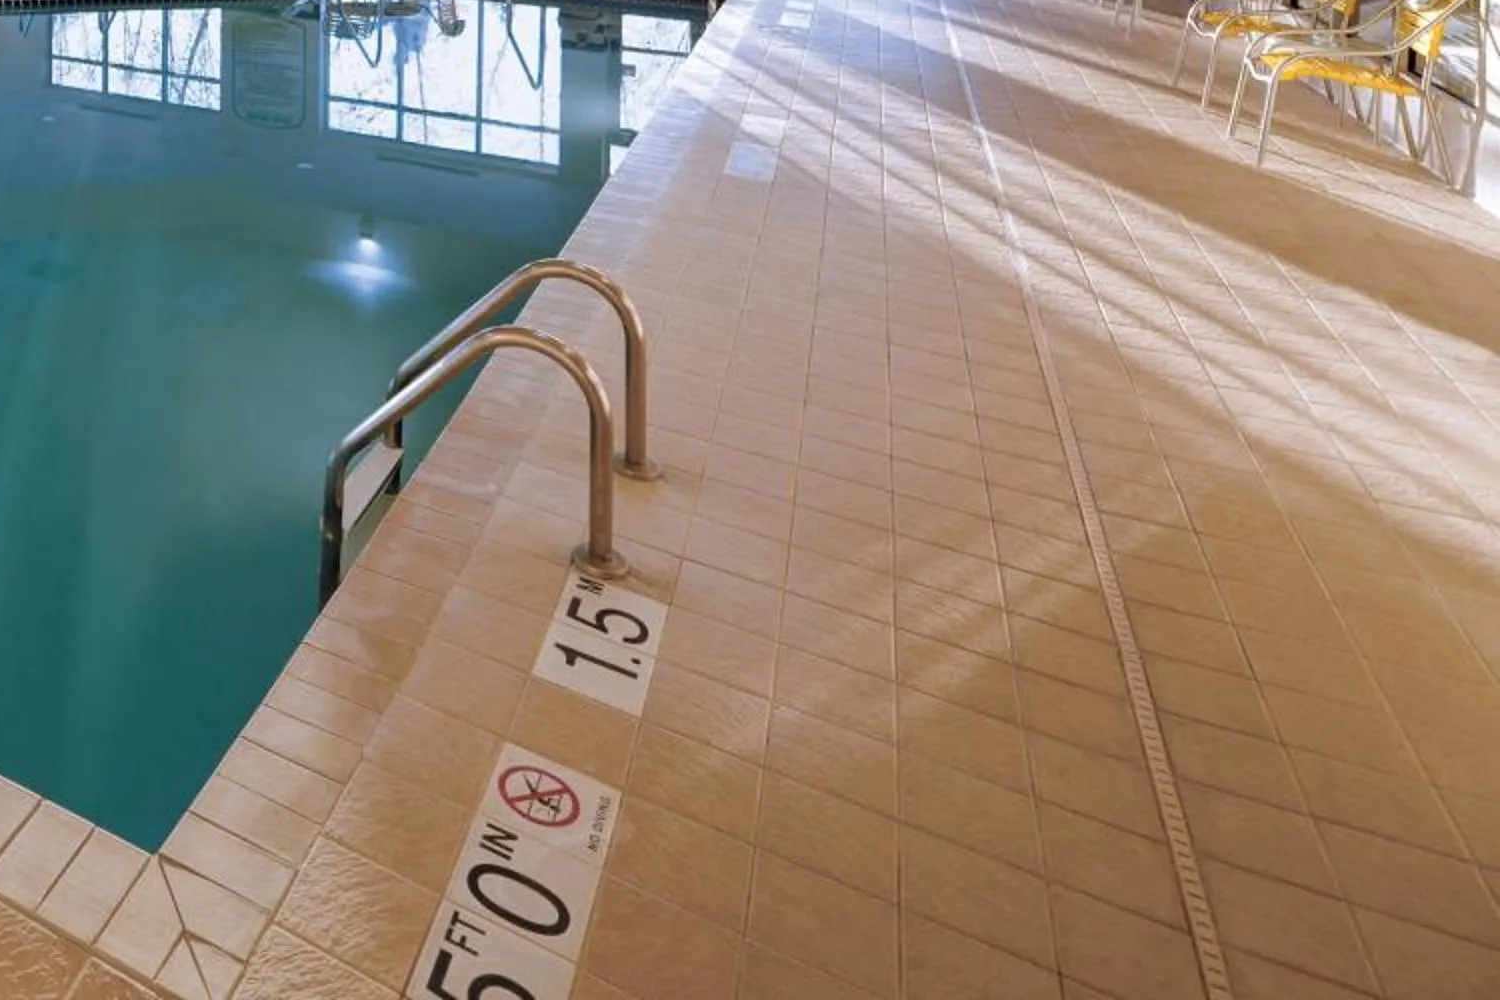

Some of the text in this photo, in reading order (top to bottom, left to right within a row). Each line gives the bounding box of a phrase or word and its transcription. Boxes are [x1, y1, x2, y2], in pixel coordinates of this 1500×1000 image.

[554, 596, 649, 680] 1.5
[478, 822, 519, 861] IN
[466, 863, 570, 937] 0
[444, 910, 486, 957] FT
